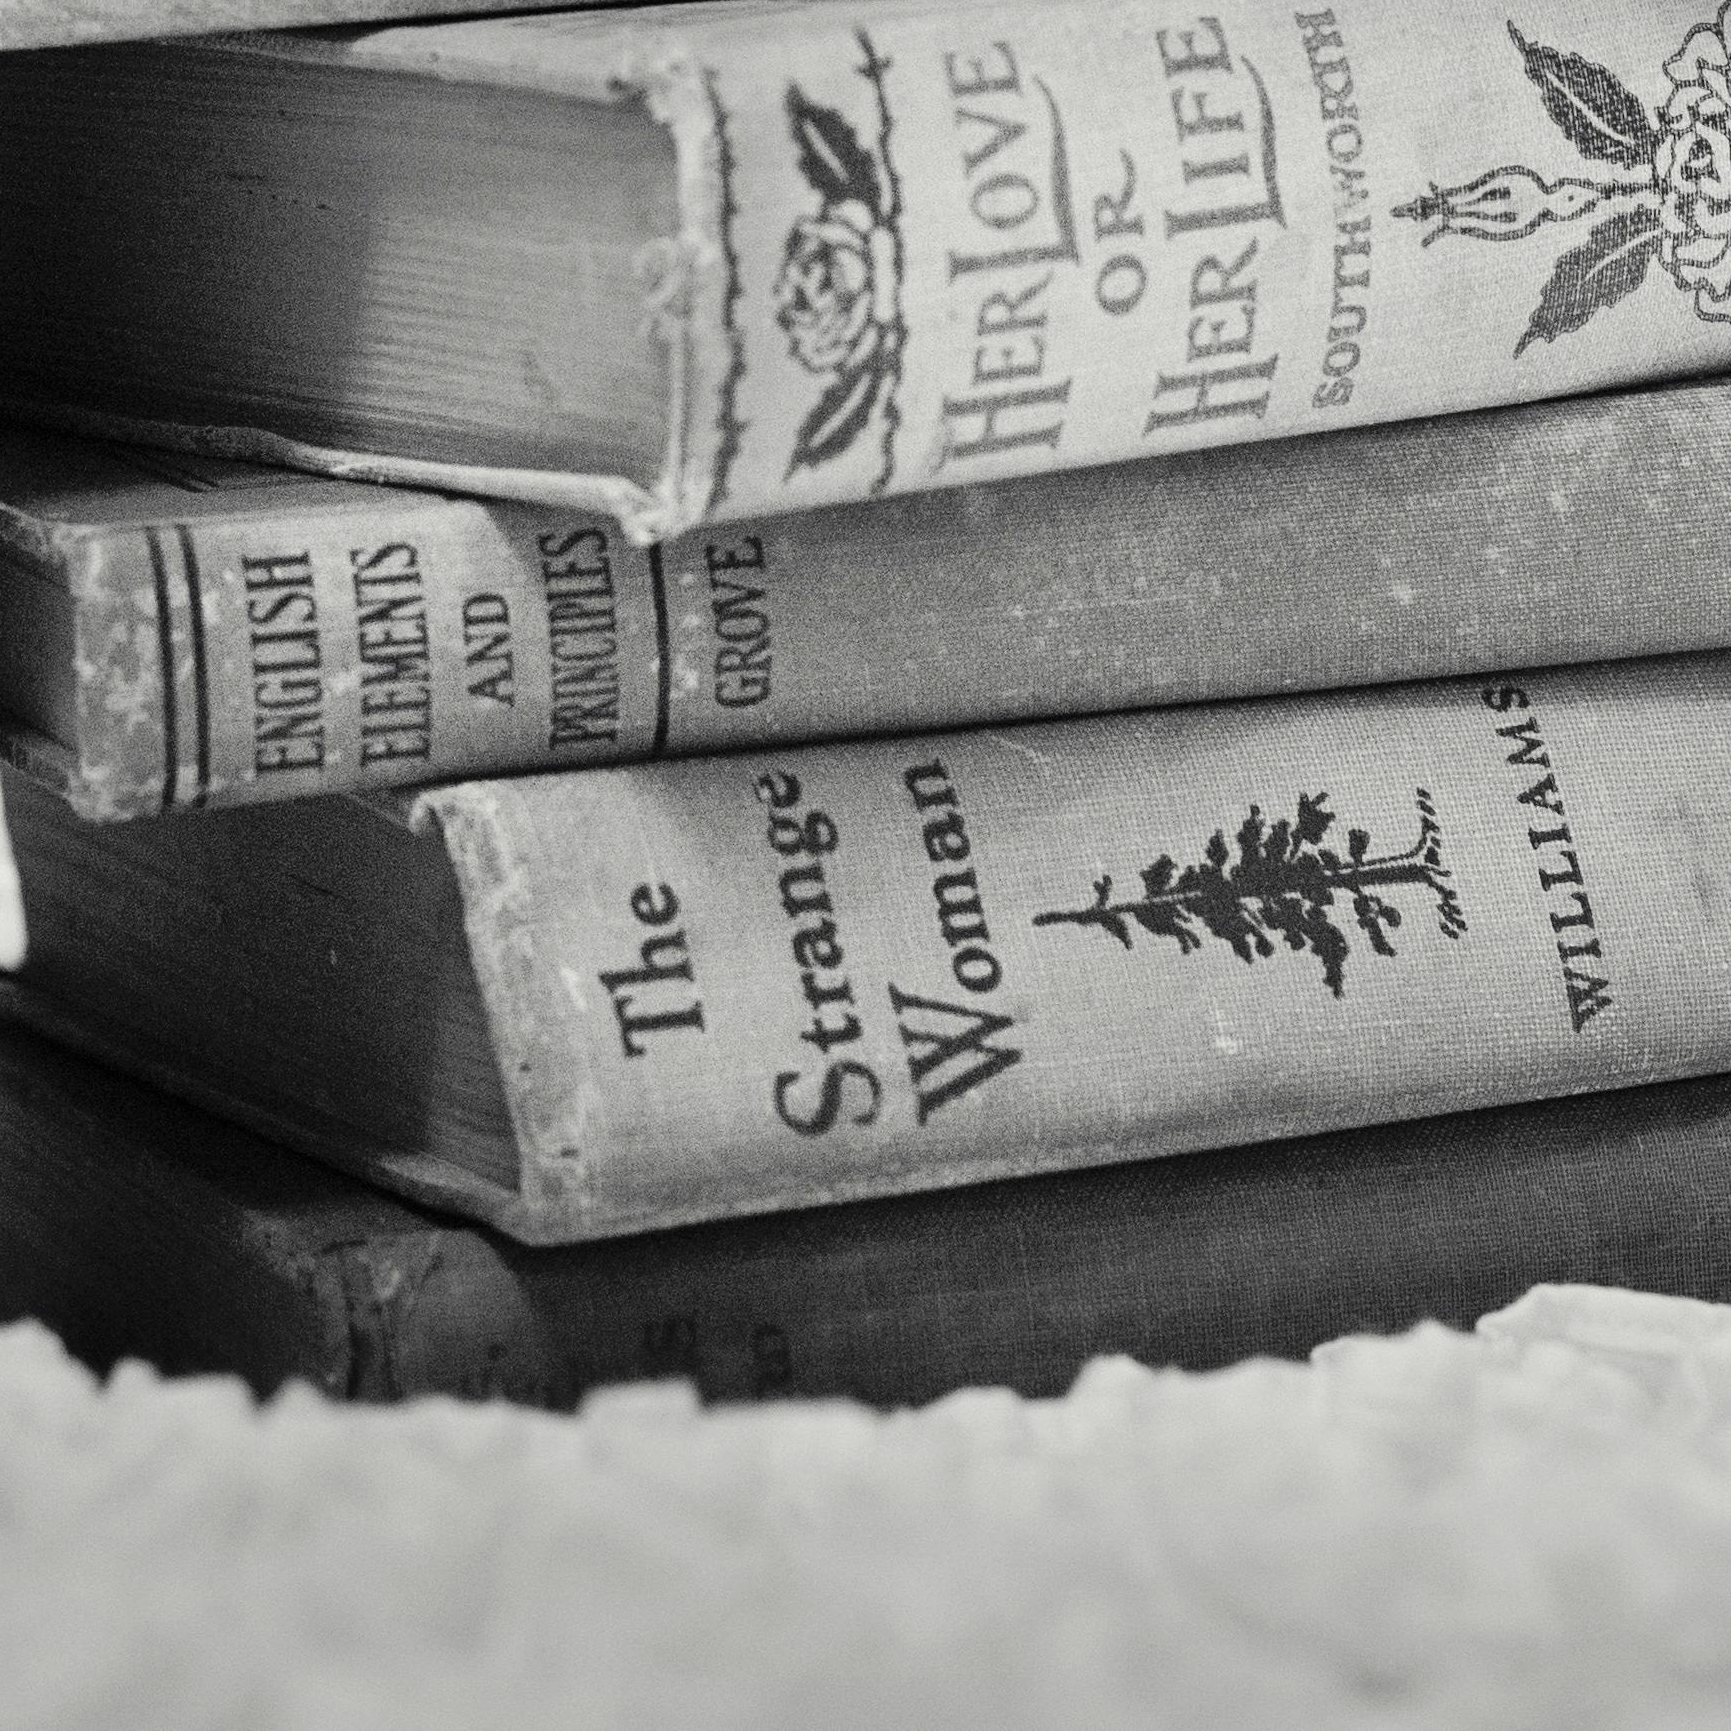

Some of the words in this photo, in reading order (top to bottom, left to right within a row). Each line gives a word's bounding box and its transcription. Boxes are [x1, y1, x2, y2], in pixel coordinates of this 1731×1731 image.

[943, 39, 1080, 284] LOVE
[1093, 147, 1147, 316] OR
[1156, 15, 1287, 240] LIFE
[1294, 7, 1372, 411] SOUTHWORTH
[939, 269, 1072, 465] HER
[1142, 236, 1278, 437] HER
[241, 550, 325, 774] ENGLISH
[349, 541, 432, 767] ELEMENTS
[462, 591, 516, 708] AND
[538, 526, 621, 751] PRINCIPLES
[705, 535, 772, 709] GROVE
[598, 881, 706, 1058] The
[752, 769, 883, 1137] Strange
[888, 756, 1024, 1127] Woman
[1481, 685, 1613, 1034] WILLIAMS
